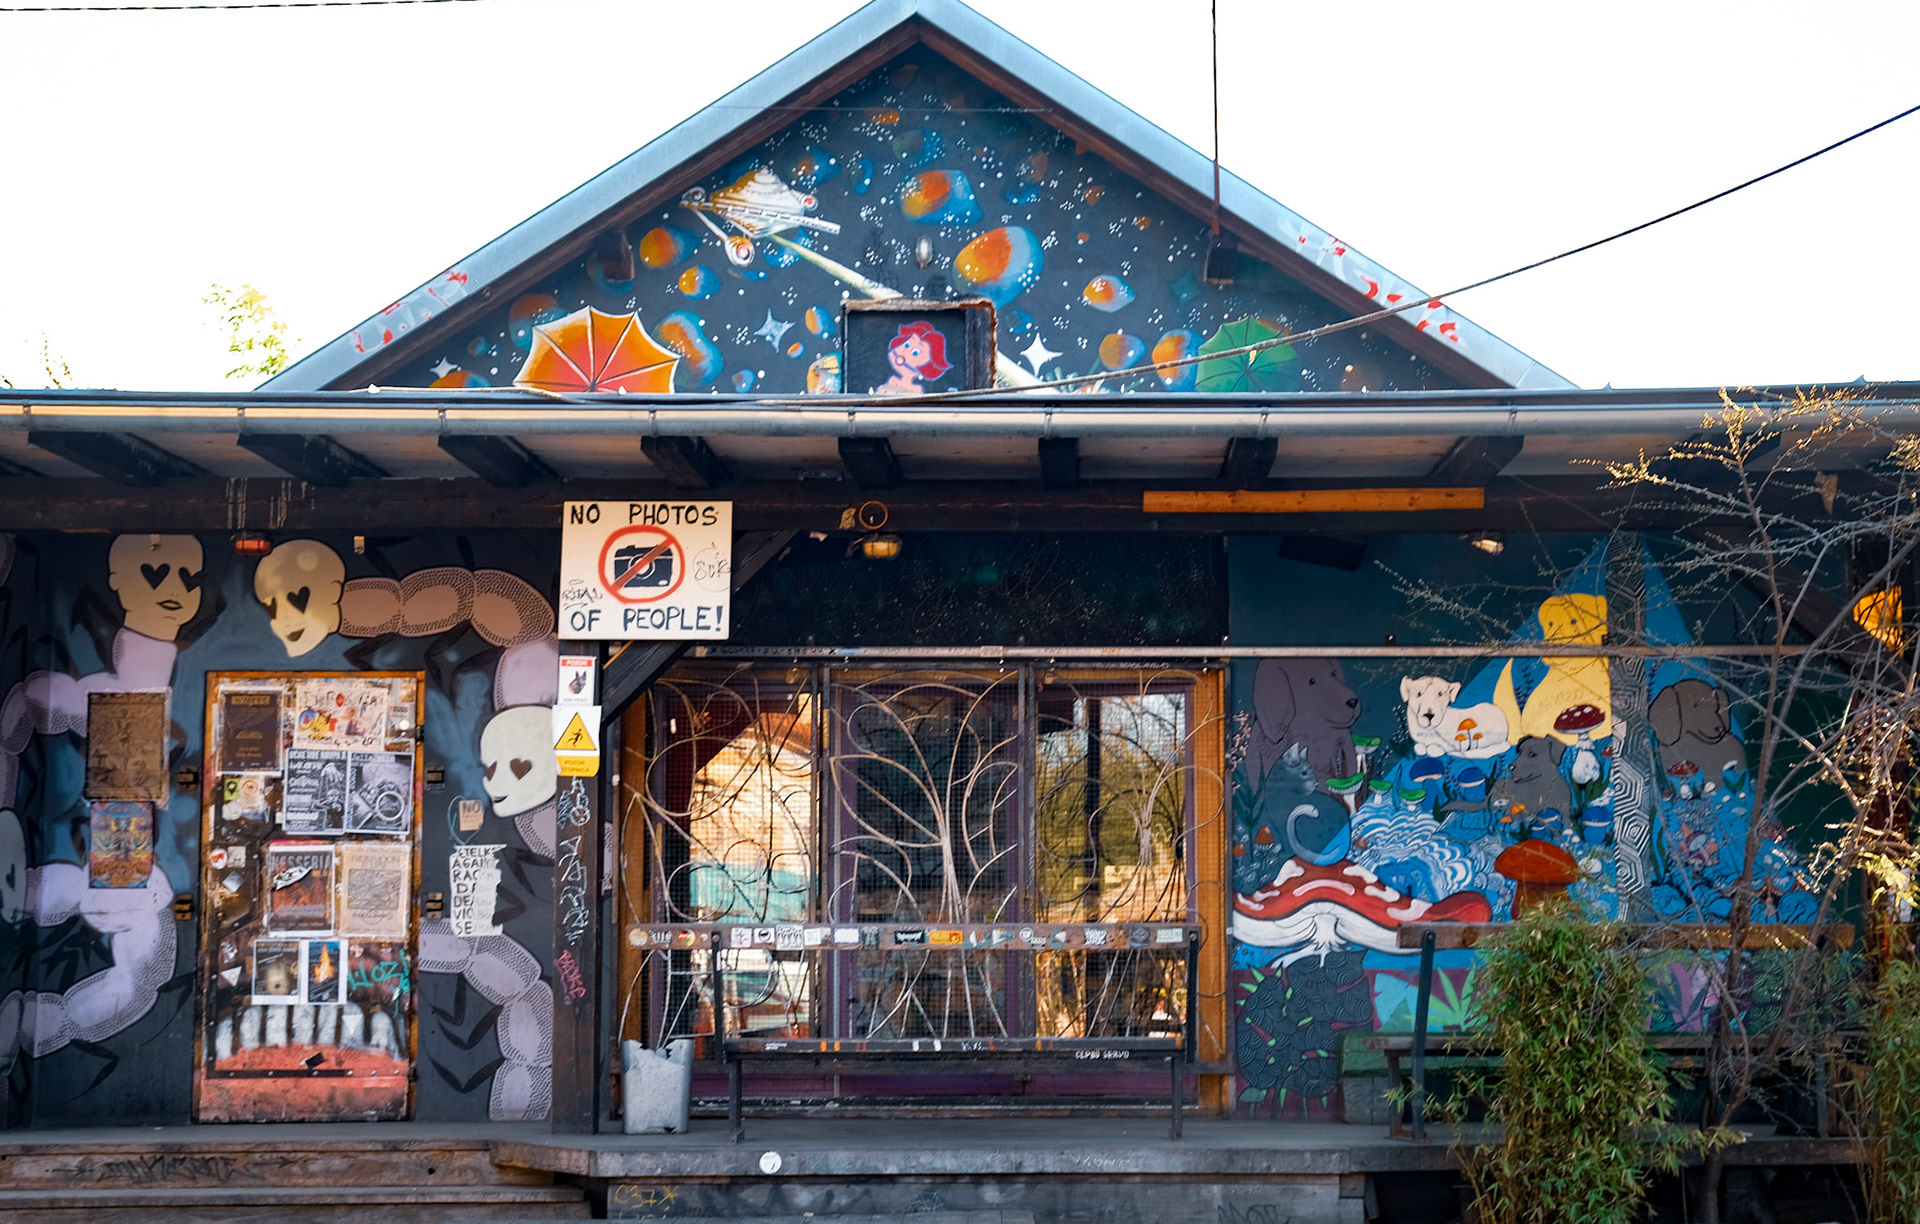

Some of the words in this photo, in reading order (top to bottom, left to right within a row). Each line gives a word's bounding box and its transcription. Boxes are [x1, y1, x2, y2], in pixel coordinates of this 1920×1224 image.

[570, 503, 600, 525] NO
[628, 503, 719, 526] PHOTOS
[570, 609, 602, 632] OF
[622, 605, 723, 632] PEOPLE!
[462, 802, 481, 814] NO
